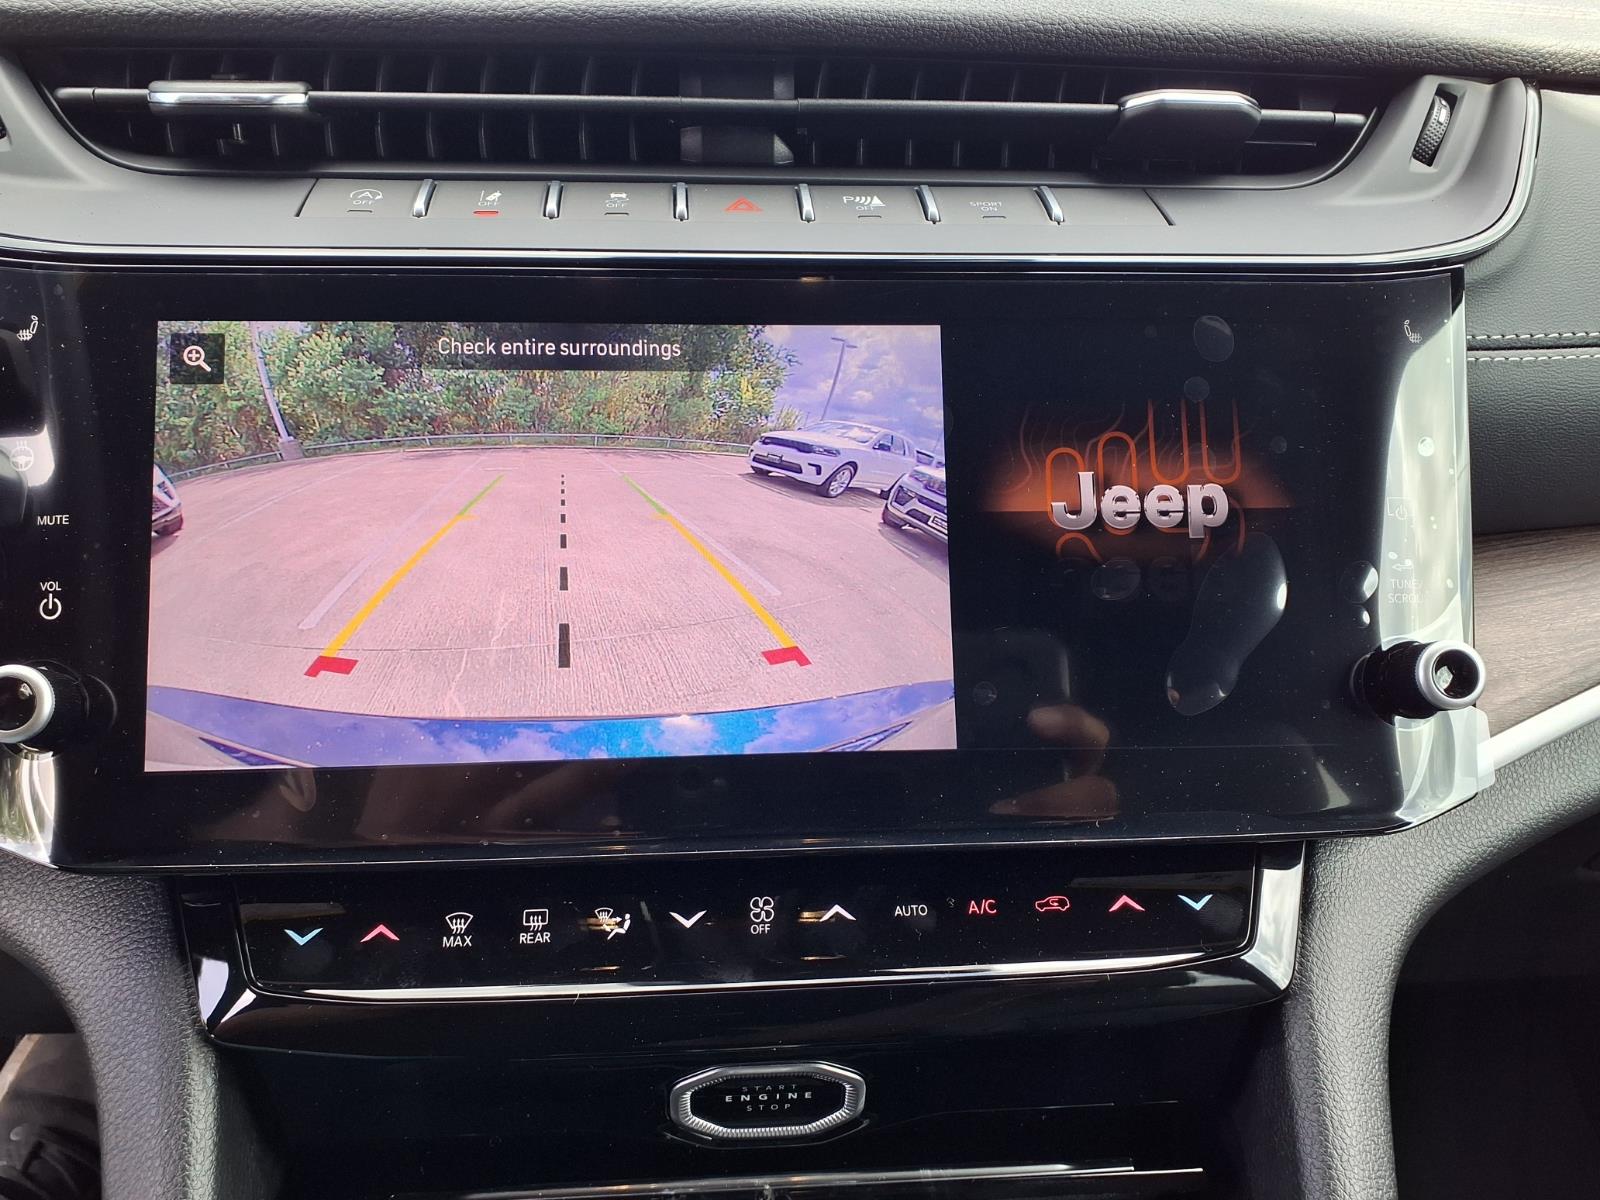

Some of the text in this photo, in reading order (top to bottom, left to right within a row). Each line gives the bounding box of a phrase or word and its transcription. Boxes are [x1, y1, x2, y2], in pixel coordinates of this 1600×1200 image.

[438, 337, 682, 361] Check entire surroundings
[1050, 471, 1229, 539] Jeep
[37, 514, 70, 526] MUTE
[40, 581, 62, 592] VOL
[894, 904, 928, 917] AUTO
[968, 899, 997, 915] A/C
[750, 924, 771, 935] OFF
[442, 935, 473, 948] MAX
[519, 932, 551, 944] REAR
[742, 1084, 798, 1092] START
[725, 1091, 812, 1102] ENGINE
[746, 1103, 791, 1112] STOP
